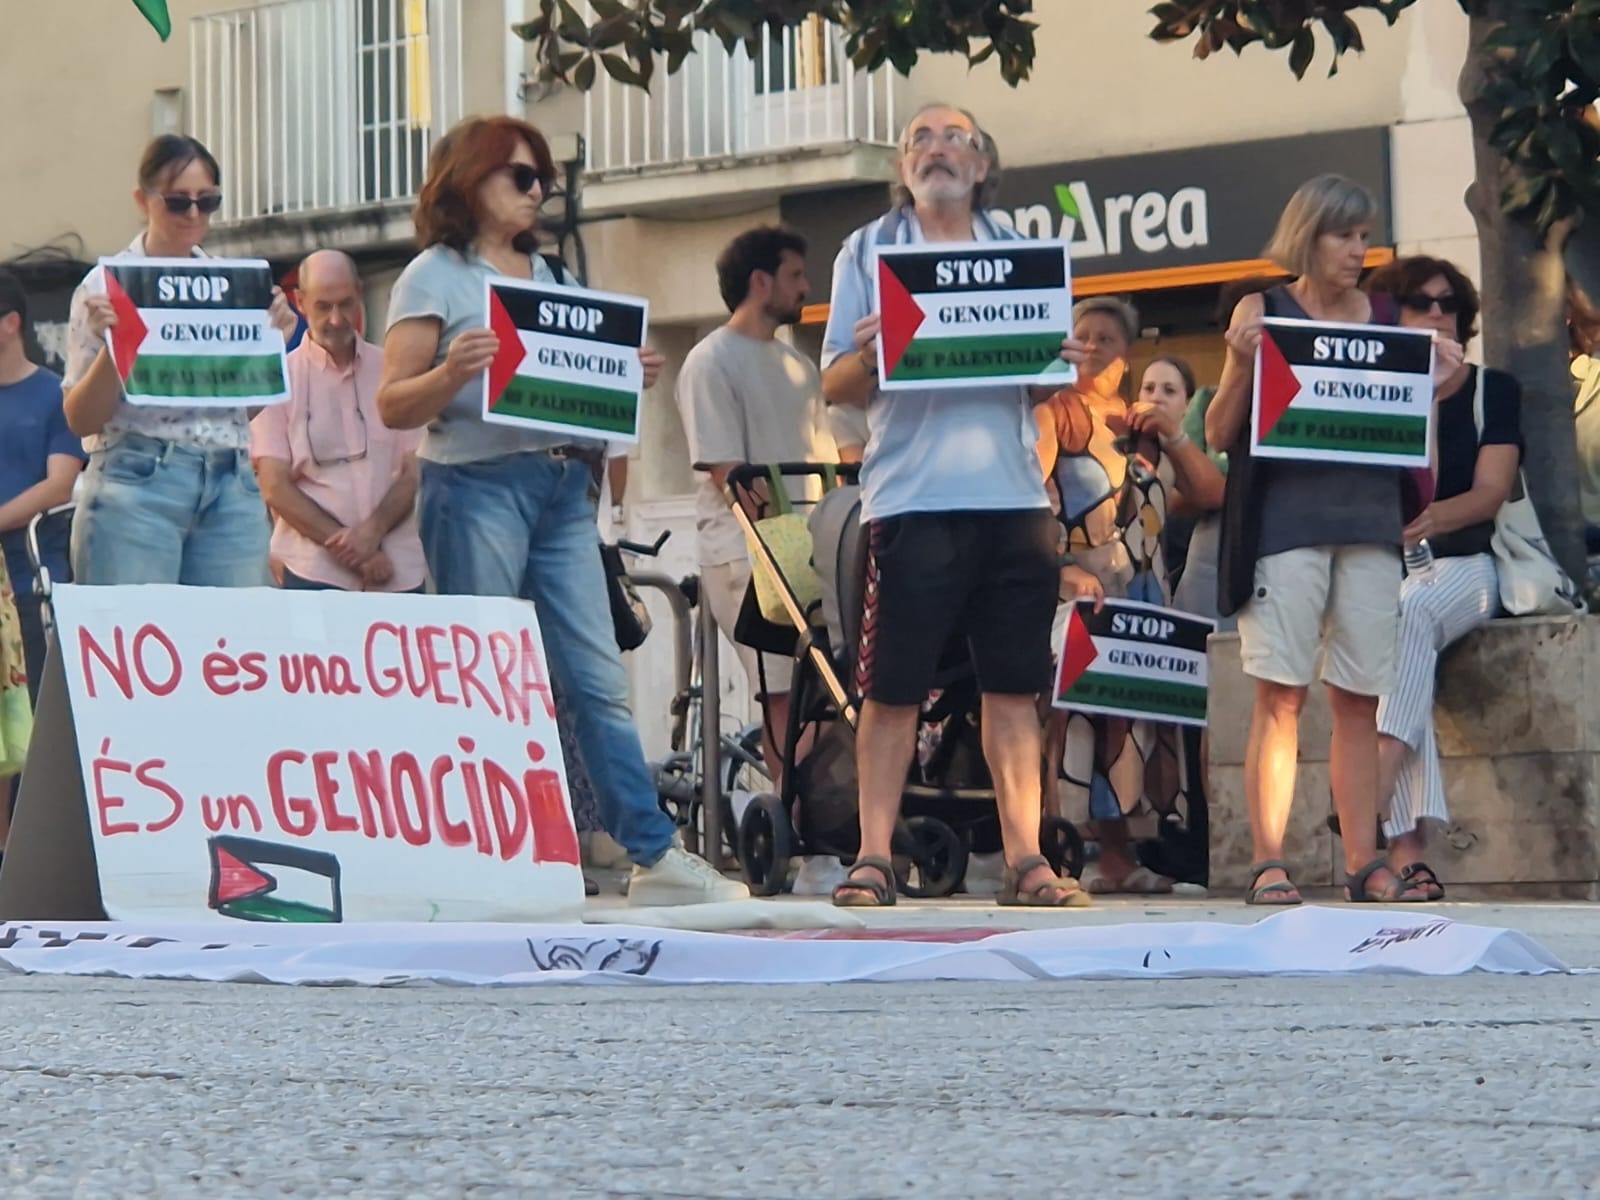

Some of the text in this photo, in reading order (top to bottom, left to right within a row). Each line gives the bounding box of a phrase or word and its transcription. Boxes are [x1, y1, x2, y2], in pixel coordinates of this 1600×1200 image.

[936, 258, 1014, 286] STOP
[158, 275, 230, 301] STOP
[538, 300, 604, 333] STOP
[938, 302, 1050, 324] GENOCIDE
[160, 323, 263, 342] GENOCIDE
[538, 346, 628, 377] GENOCIDE
[1313, 335, 1385, 364] STOP
[1313, 380, 1413, 403] GENOCIDE
[1111, 612, 1177, 639] STOP
[77, 621, 556, 725] NO és una GUERRA
[1108, 649, 1200, 676] GENOCIDE
[93, 737, 185, 837] ÉS
[201, 794, 263, 832] un
